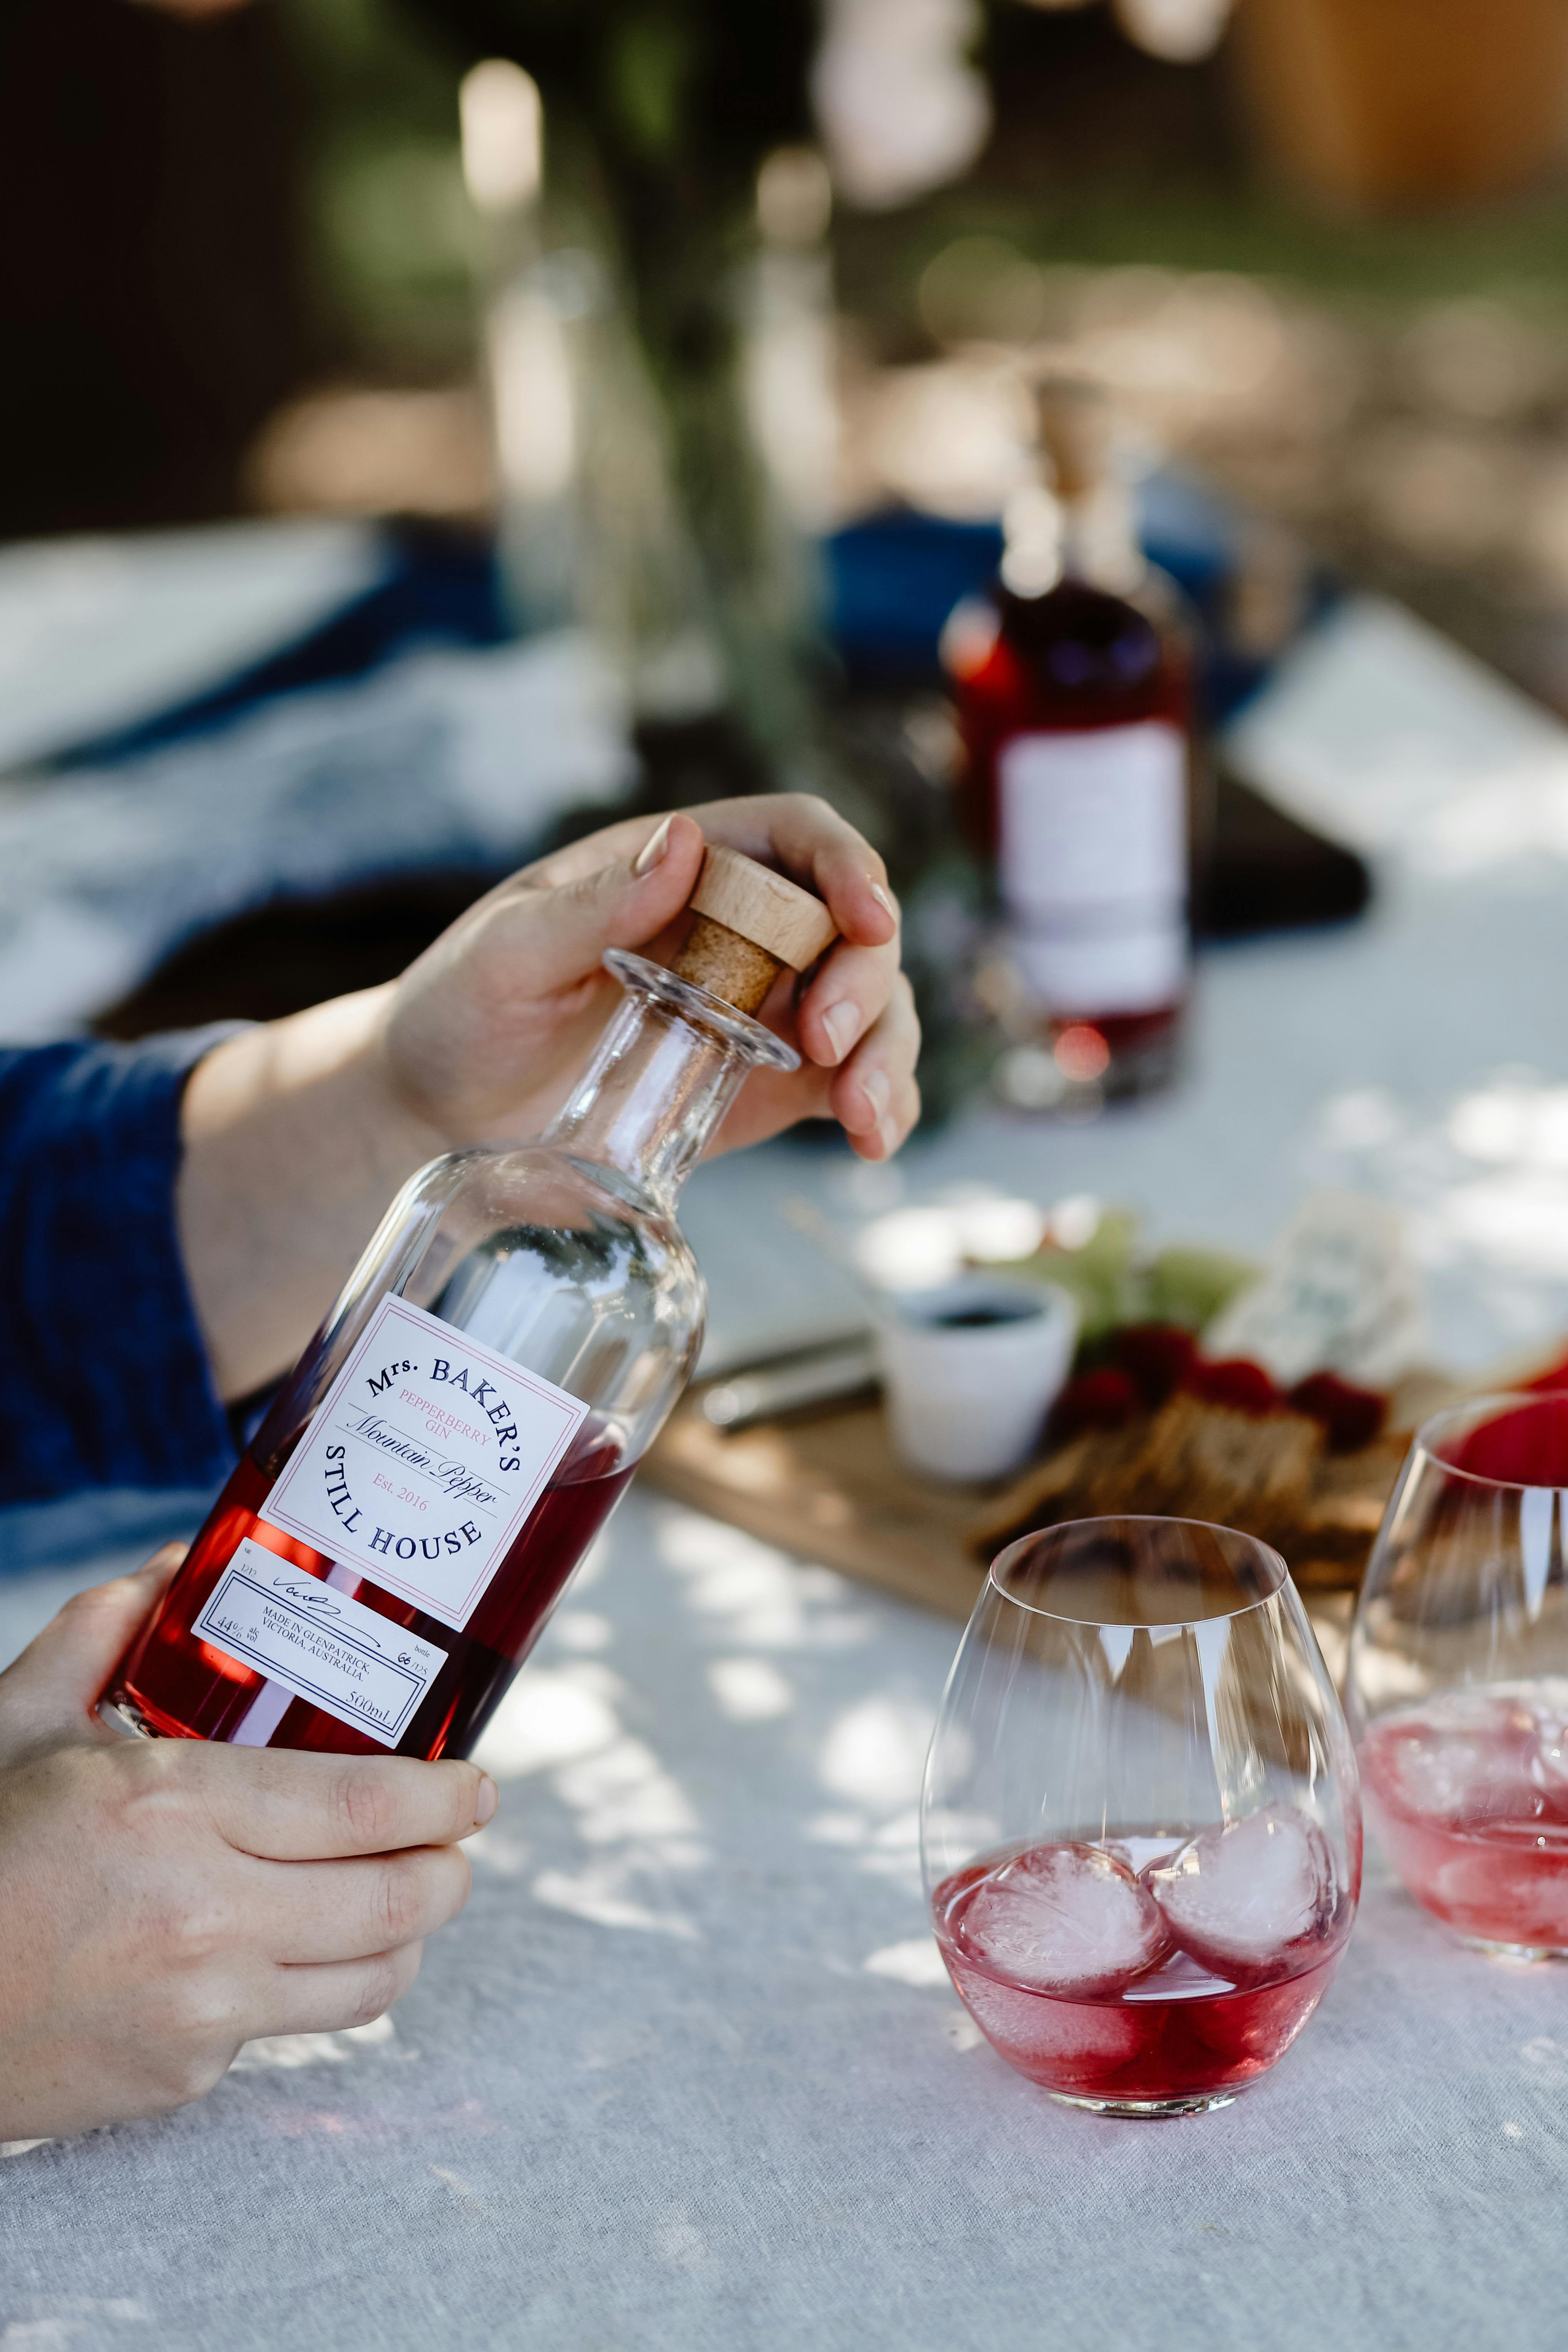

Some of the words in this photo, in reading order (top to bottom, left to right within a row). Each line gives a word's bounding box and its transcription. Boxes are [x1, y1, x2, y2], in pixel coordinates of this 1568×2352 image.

[366, 1359, 418, 1398] Mrs.
[430, 1359, 520, 1472] BAKER'S
[398, 1389, 492, 1446] PEPPERBERRY
[425, 1421, 452, 1440] GIN
[346, 1415, 435, 1470] Mountain
[429, 1461, 497, 1505] Pepper
[325, 1445, 364, 1533] STILL
[368, 1520, 482, 1560] HOUSE
[372, 1473, 393, 1495] Est.
[397, 1487, 427, 1512] 2016
[218, 1617, 243, 1639] 44%
[247, 1633, 258, 1642] vol
[249, 1627, 259, 1637] alc
[263, 1606, 291, 1627] MADE
[291, 1622, 303, 1633] IN
[304, 1630, 370, 1674] GLENPATRICK,
[263, 1617, 305, 1649] VICTORIA,
[308, 1646, 363, 1681] AUSTRALIA.
[415, 1645, 430, 1657] bottle
[346, 1691, 391, 1724] 500mL
